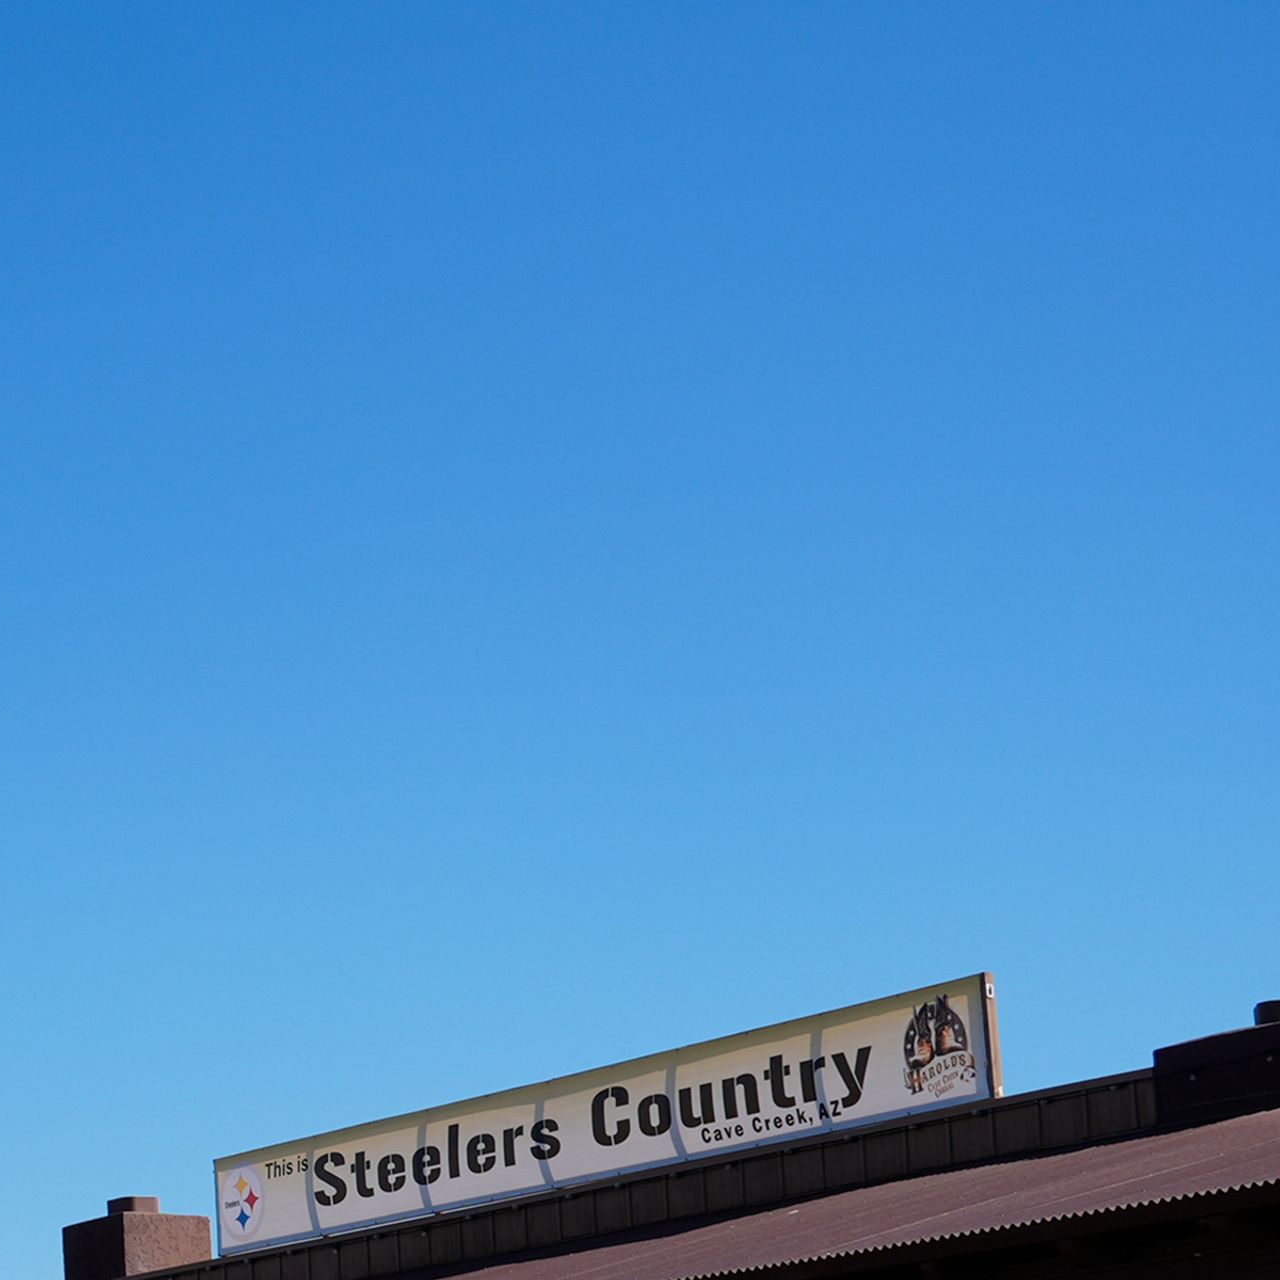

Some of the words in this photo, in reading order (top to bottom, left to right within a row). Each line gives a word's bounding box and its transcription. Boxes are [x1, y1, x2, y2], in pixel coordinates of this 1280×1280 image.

[265, 1159, 293, 1179] This
[297, 1155, 309, 1172] is
[313, 1114, 561, 1207] Steelers
[590, 1044, 873, 1147] Country
[701, 1124, 745, 1143] Cave
[752, 1108, 814, 1133] Creek,
[819, 1100, 842, 1120] AZ
